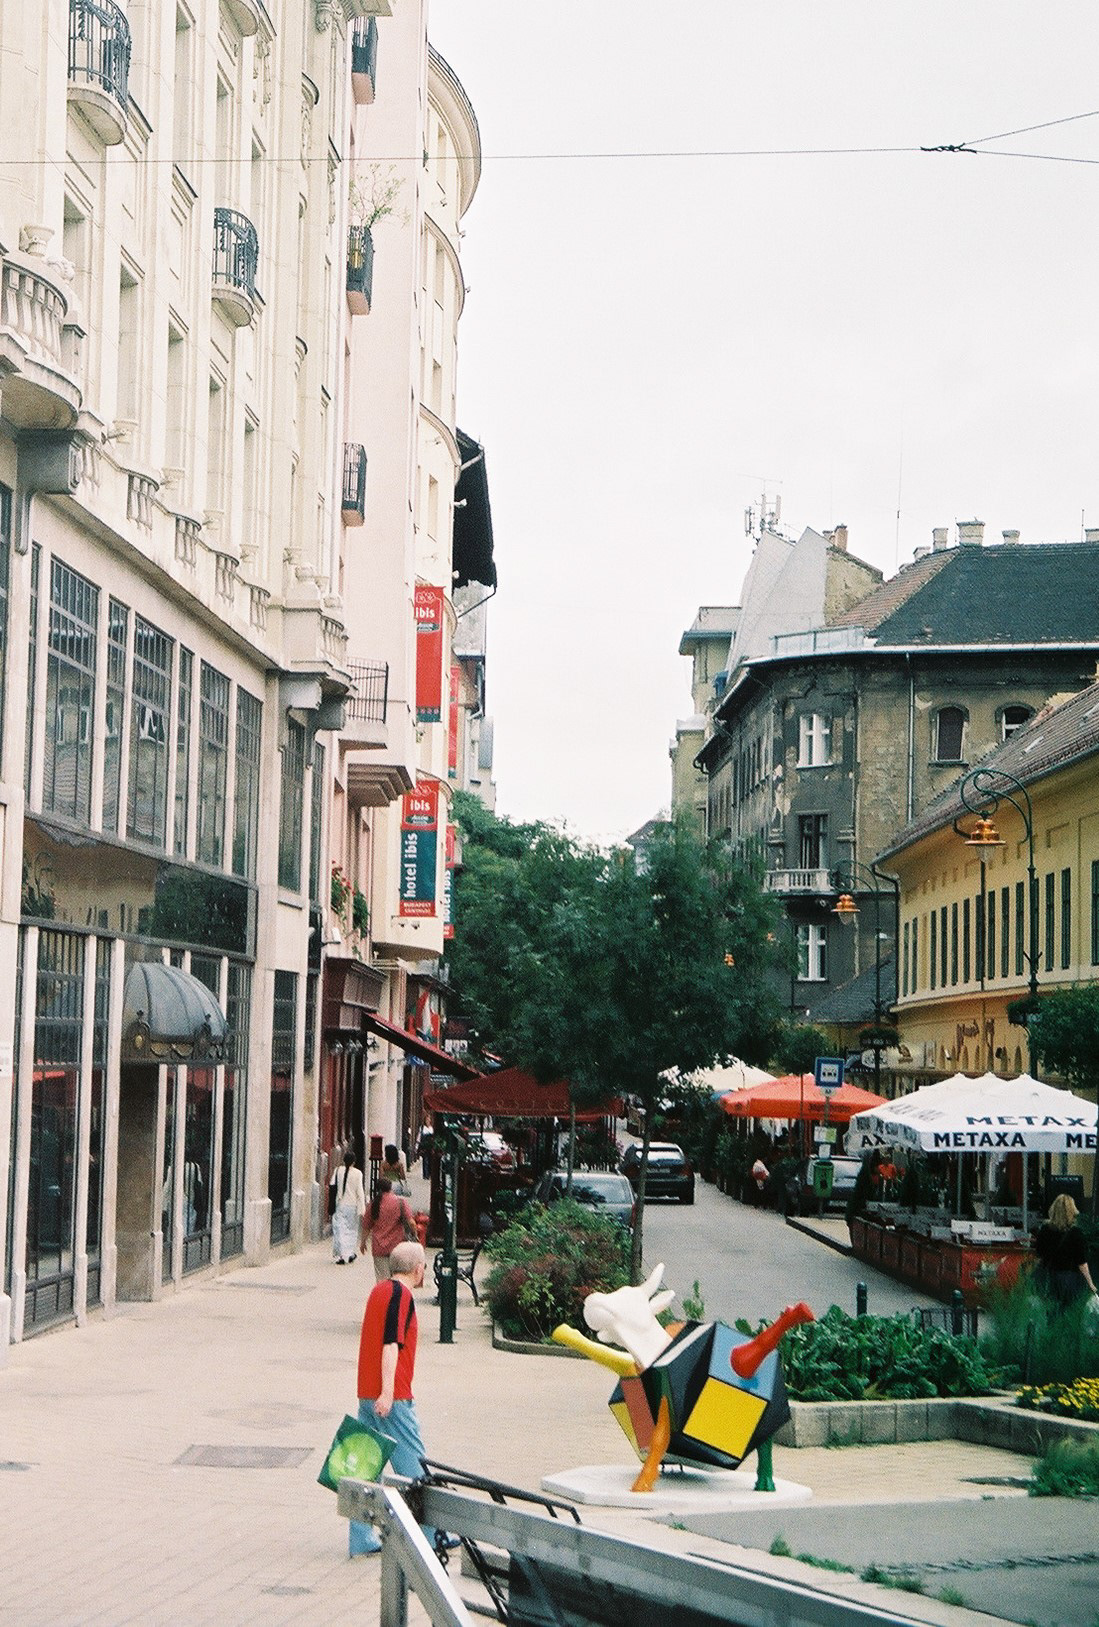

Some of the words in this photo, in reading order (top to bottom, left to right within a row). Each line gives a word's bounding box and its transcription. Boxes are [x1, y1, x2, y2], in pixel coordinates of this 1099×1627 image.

[415, 607, 435, 618] ibis
[410, 799, 431, 811] ibis
[404, 832, 418, 859] ibis
[403, 863, 417, 898] hotel
[966, 1116, 1098, 1127] METAX
[933, 1132, 1027, 1148] METAXA
